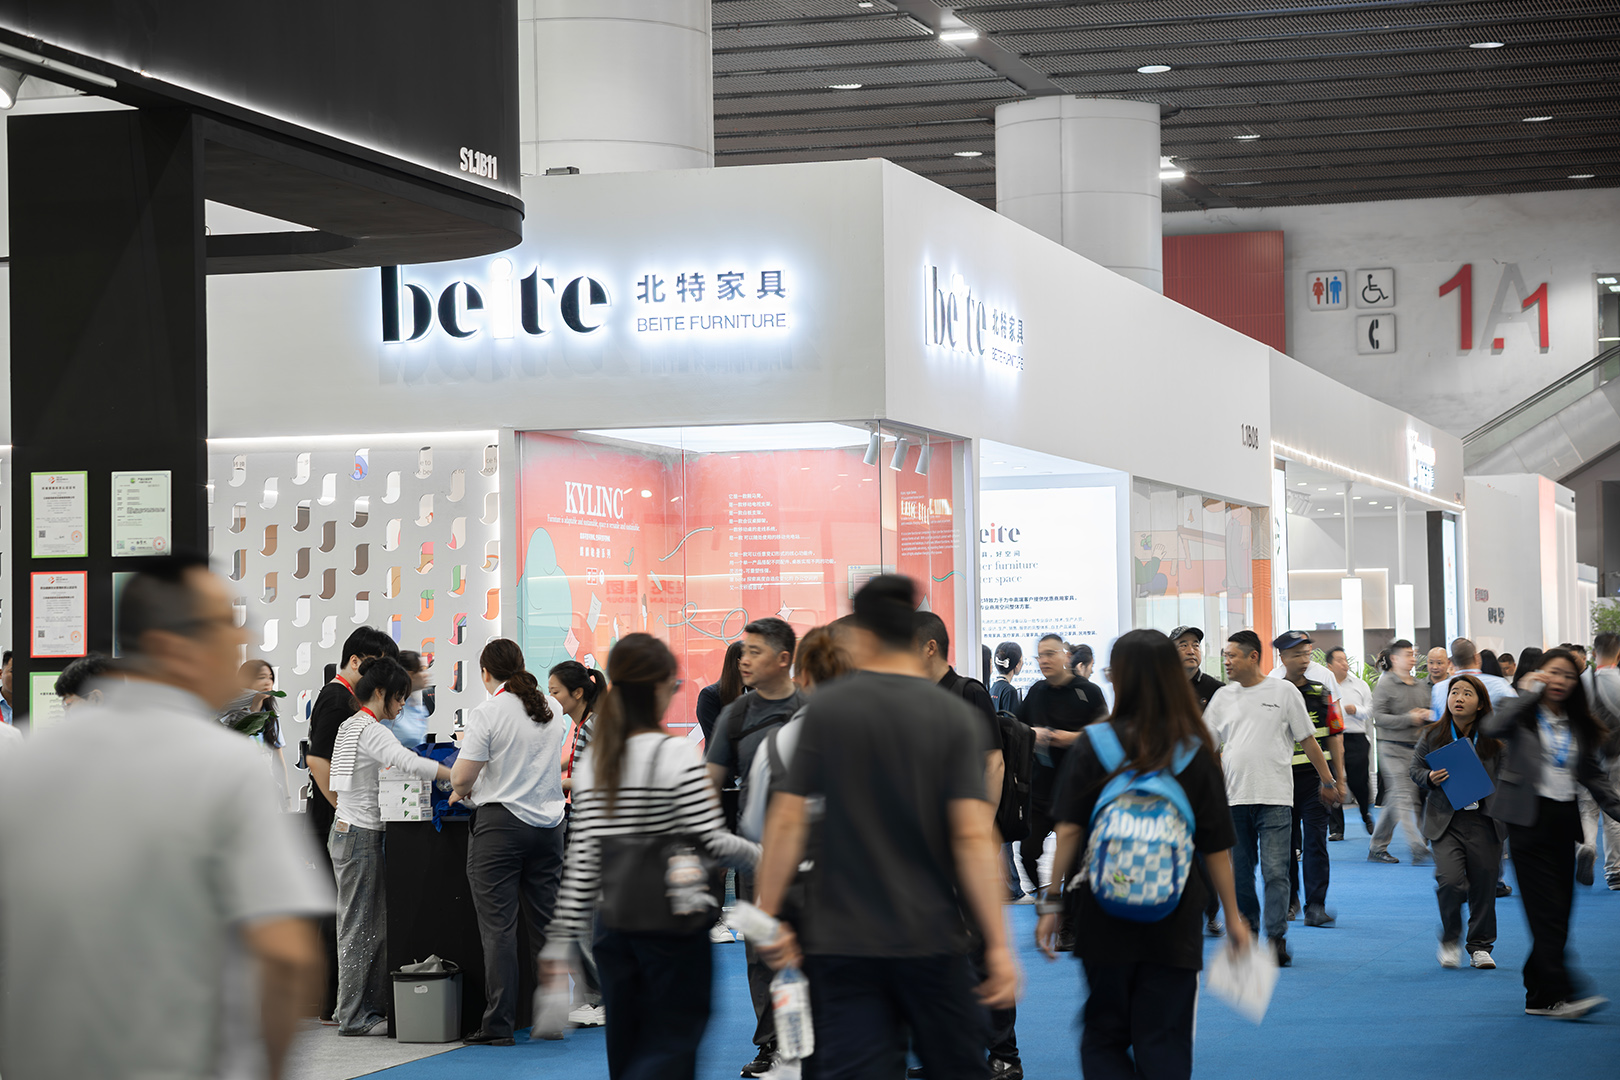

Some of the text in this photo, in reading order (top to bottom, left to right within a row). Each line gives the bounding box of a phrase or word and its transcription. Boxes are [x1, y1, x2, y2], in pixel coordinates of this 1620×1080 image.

[460, 146, 498, 180] S1.1B11
[637, 270, 786, 303] 北特家具
[380, 257, 612, 344] beite
[637, 313, 786, 332] BEITE FURNITURE
[995, 560, 1039, 570] furniture
[996, 575, 1022, 586] space
